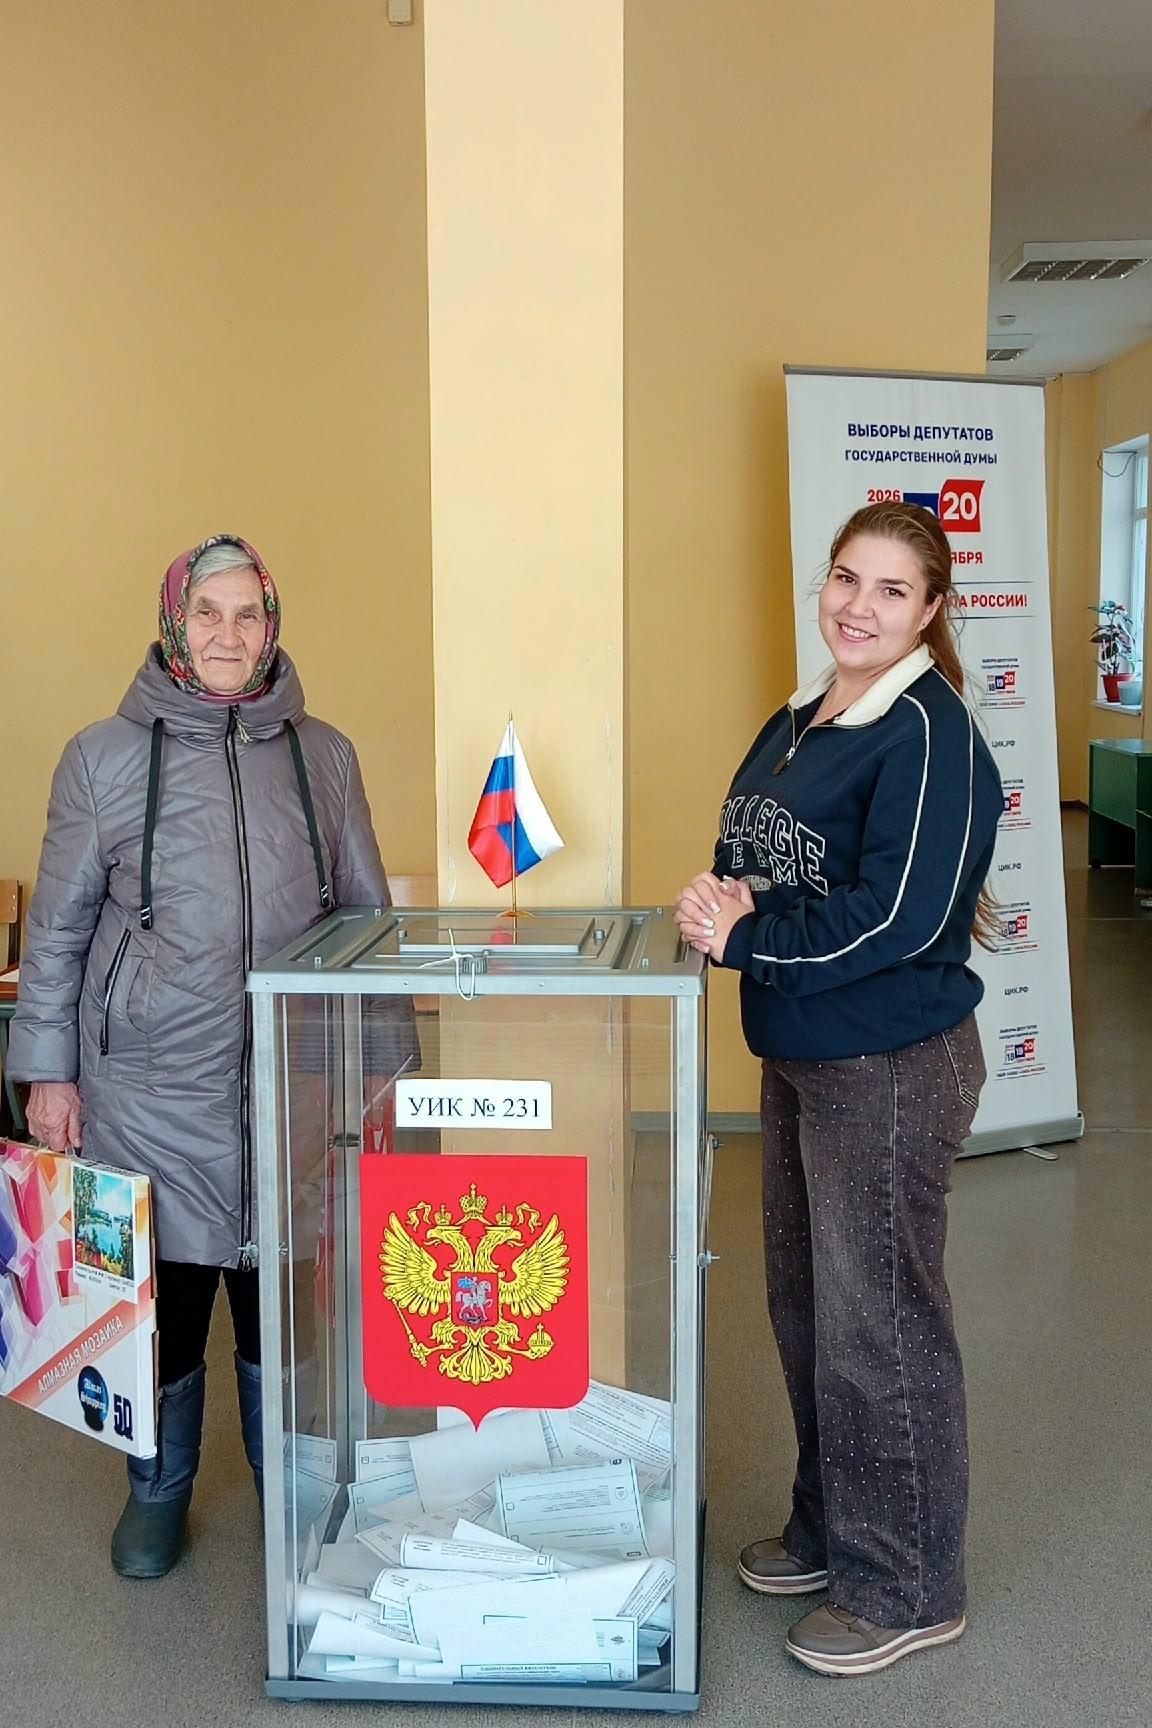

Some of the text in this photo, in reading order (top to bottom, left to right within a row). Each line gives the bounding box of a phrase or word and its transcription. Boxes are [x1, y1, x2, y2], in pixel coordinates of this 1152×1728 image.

[848, 423, 993, 441] ВЫБОРЫ ДЕПУТАТОВ
[845, 449, 997, 465] ГОСУДАРСТВЕННОЙ ДУМЫ
[867, 489, 900, 502] 2026
[943, 492, 977, 520] 20
[951, 551, 983, 564] ЯБРЯ
[971, 593, 1027, 608] РОССИИ!
[1004, 674, 1014, 683] 20
[720, 795, 828, 896] LLEGE
[1017, 919, 1026, 928] 20
[1004, 986, 1029, 995] ЦИК.РФ
[407, 1097, 539, 1117] УИК № 231
[37, 1315, 124, 1394] АЛМАЗНАЯ МОЗАИКА
